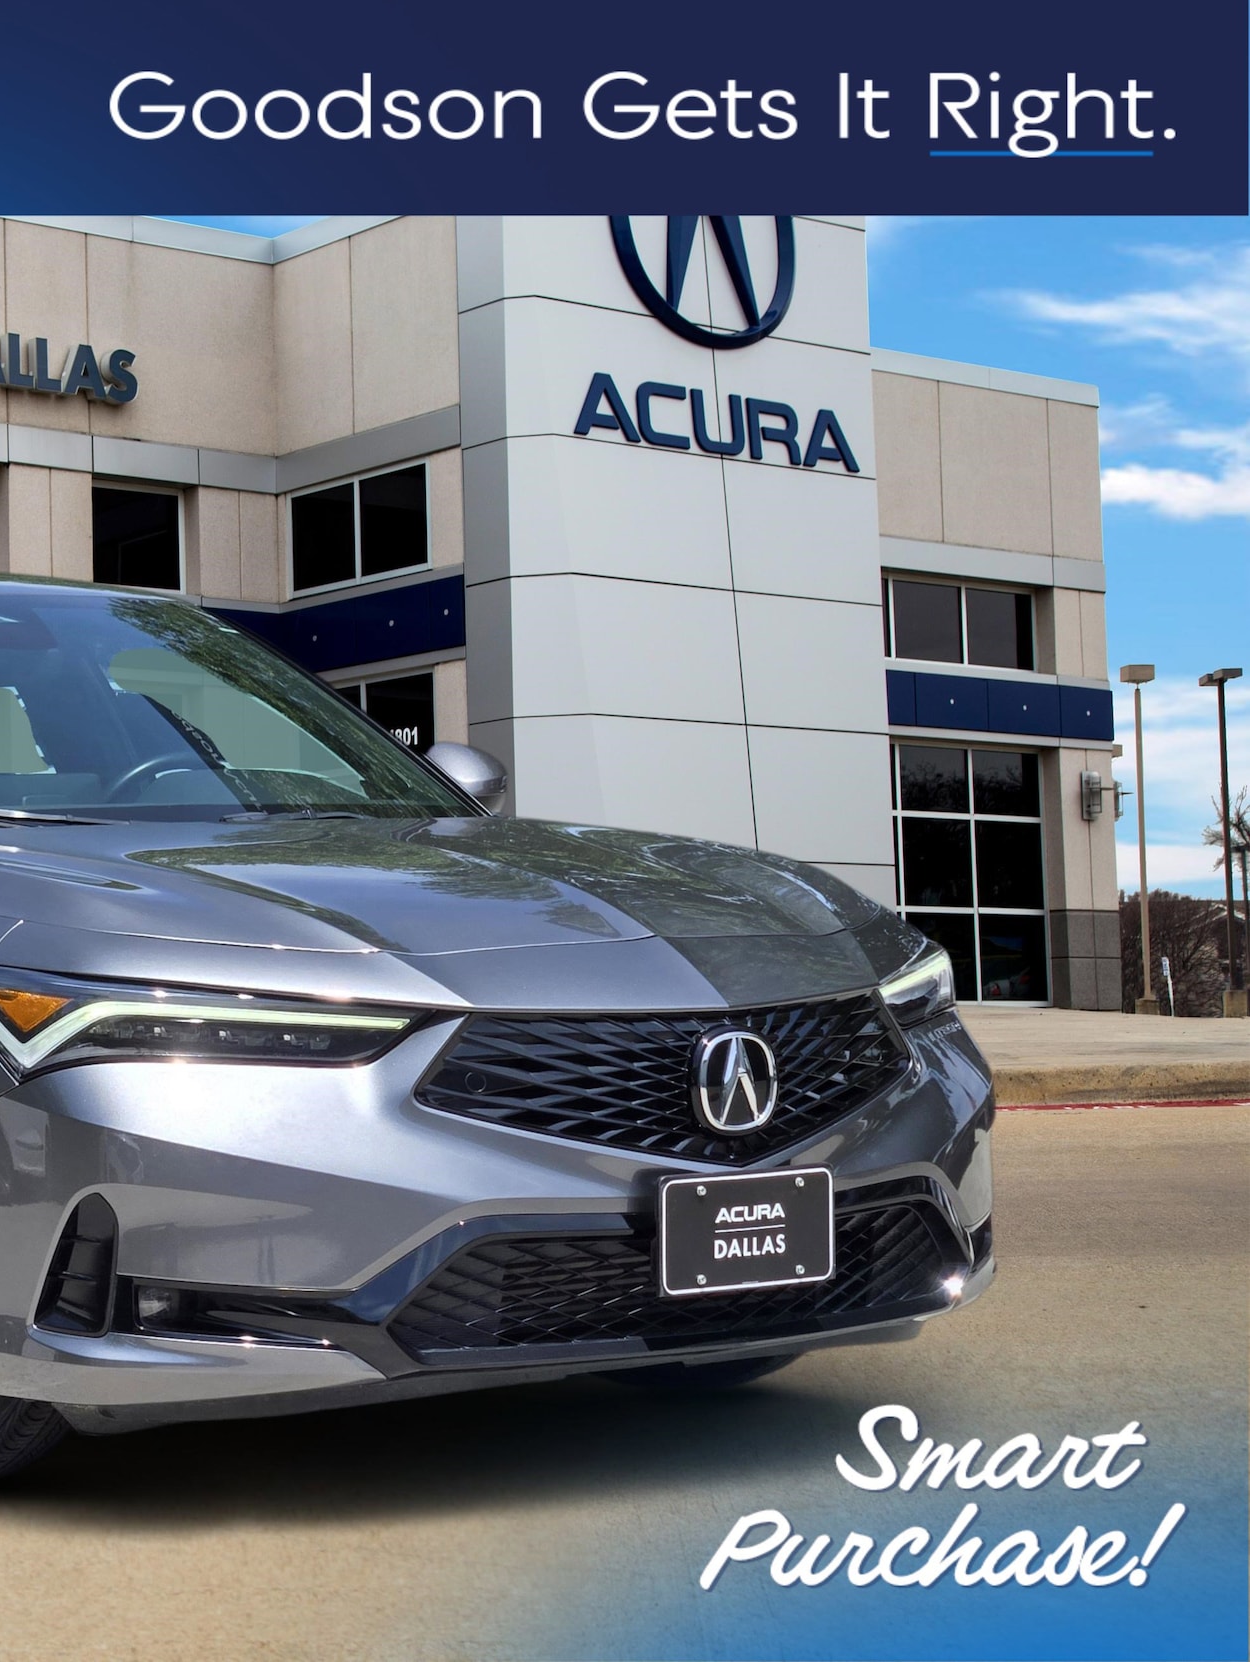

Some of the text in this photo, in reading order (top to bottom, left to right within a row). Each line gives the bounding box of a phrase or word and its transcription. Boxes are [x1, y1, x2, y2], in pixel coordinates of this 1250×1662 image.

[573, 372, 861, 473] ACURA
[715, 1203, 785, 1223] ACURA
[713, 1234, 786, 1259] DALLAS
